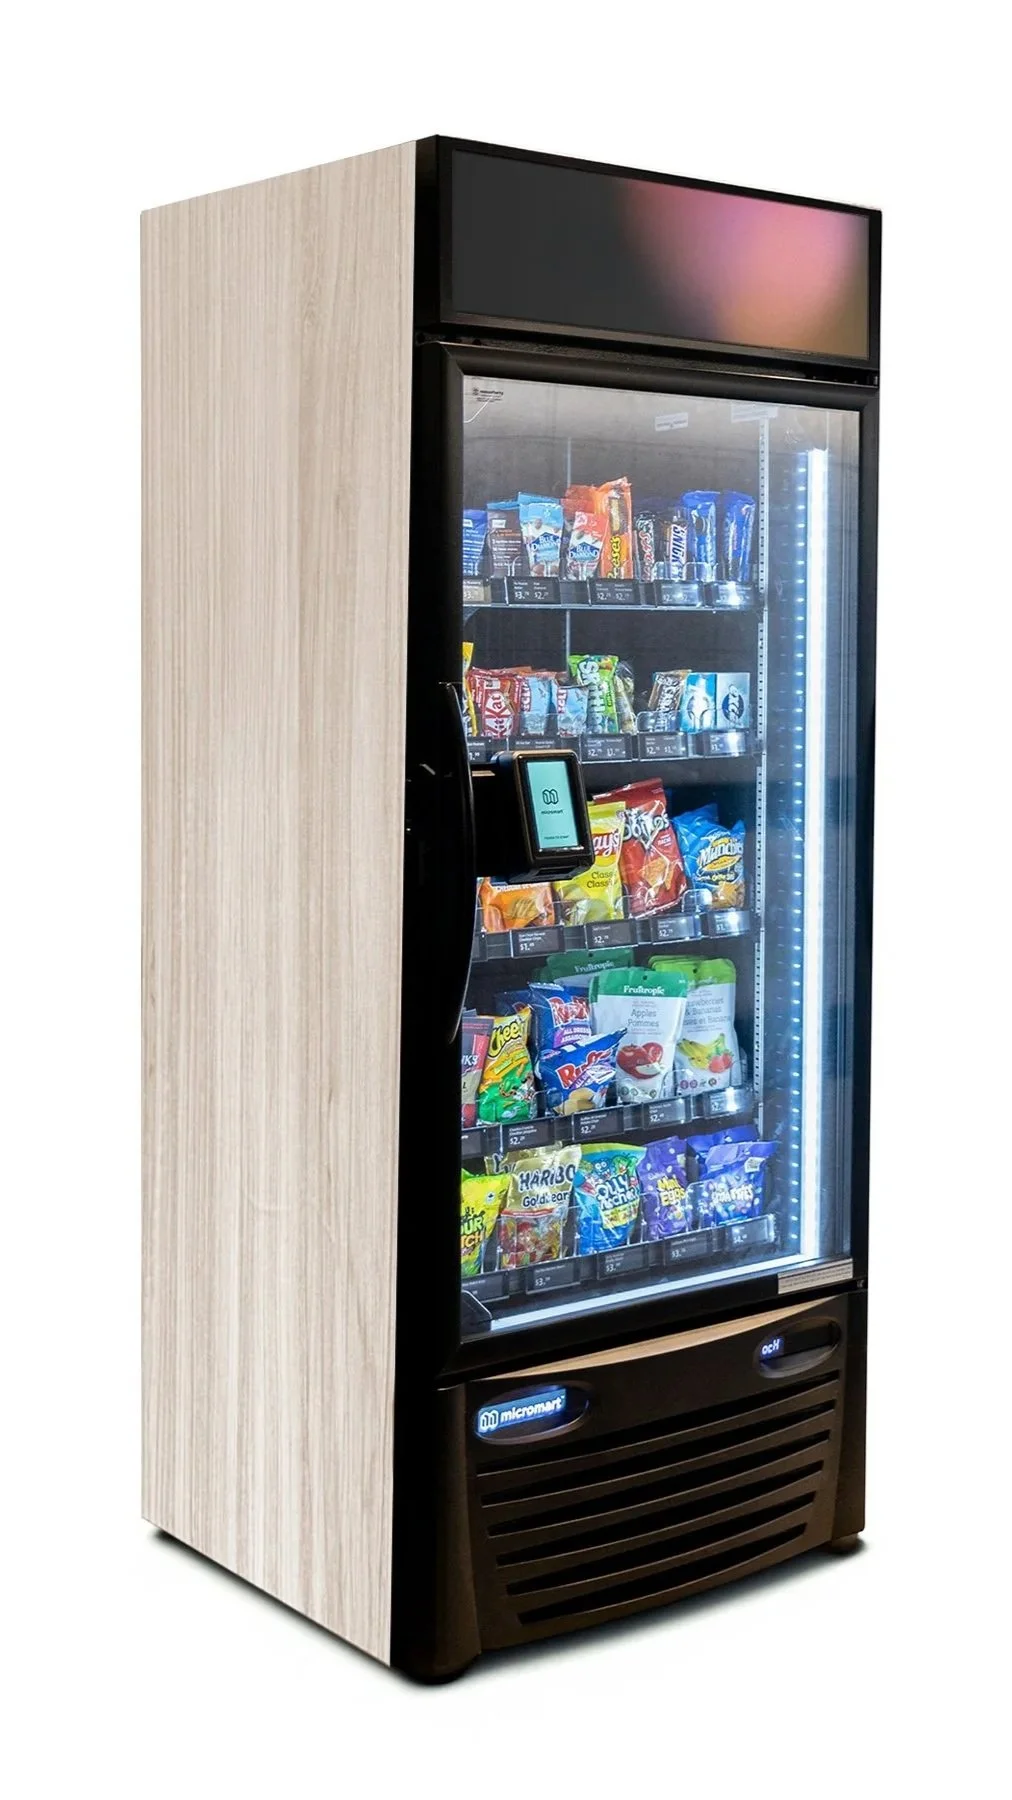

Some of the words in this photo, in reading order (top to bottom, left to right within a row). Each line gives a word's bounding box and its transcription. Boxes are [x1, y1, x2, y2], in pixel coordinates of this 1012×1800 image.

[593, 828, 620, 857] ay's
[631, 1009, 657, 1019] Apples
[500, 1397, 562, 1423] micromart
